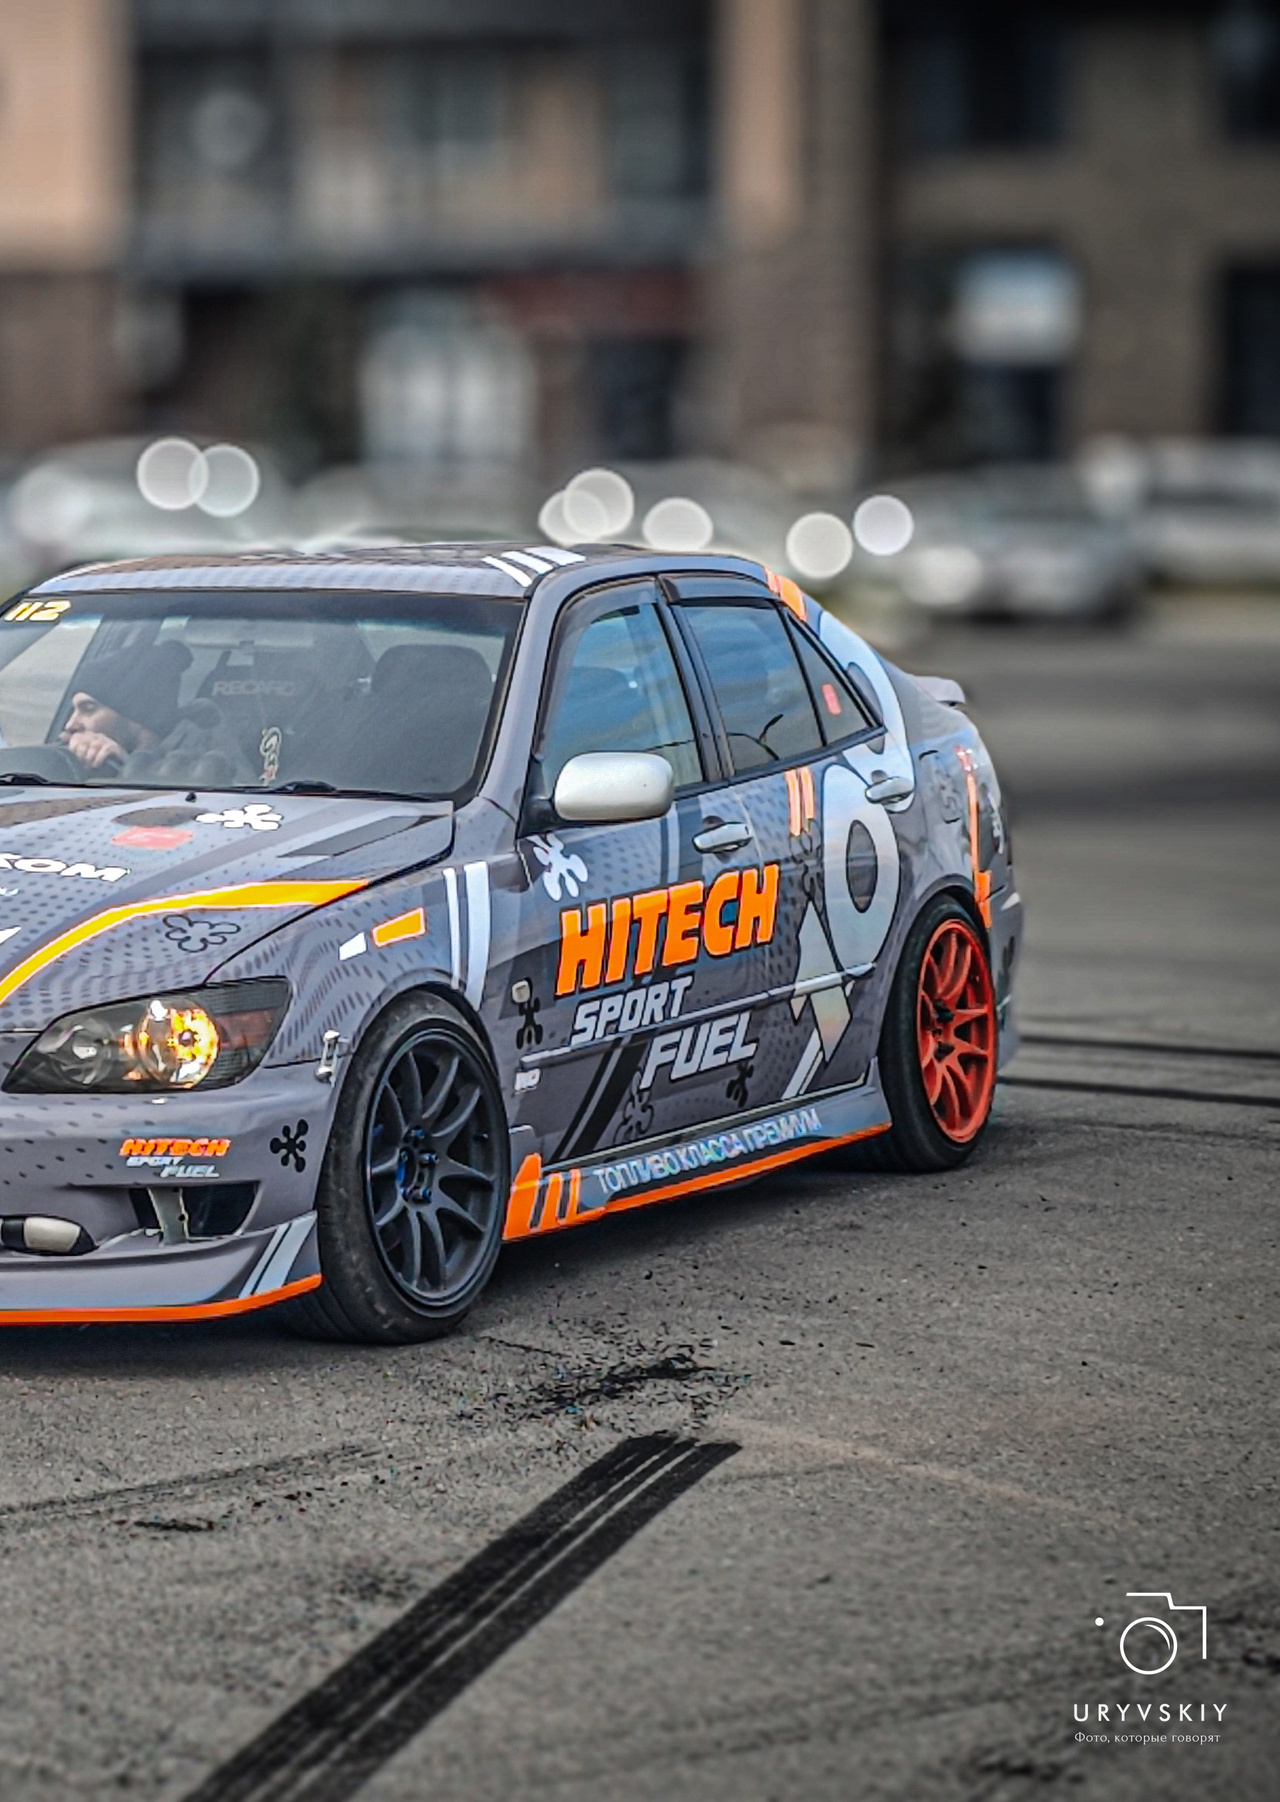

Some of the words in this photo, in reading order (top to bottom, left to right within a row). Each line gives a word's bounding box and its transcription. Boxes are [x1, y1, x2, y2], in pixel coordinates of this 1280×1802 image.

[3, 600, 72, 622] 112
[555, 862, 780, 997] HITECH
[570, 974, 695, 1046] SPORT
[638, 1011, 759, 1090] FUEL
[119, 1138, 232, 1157] HITECH
[160, 1164, 220, 1178] FUEL
[592, 1150, 680, 1194] ТОПЛИВО
[678, 1135, 748, 1172] КЛАССА
[743, 1106, 824, 1153] ПРЕМИУМ
